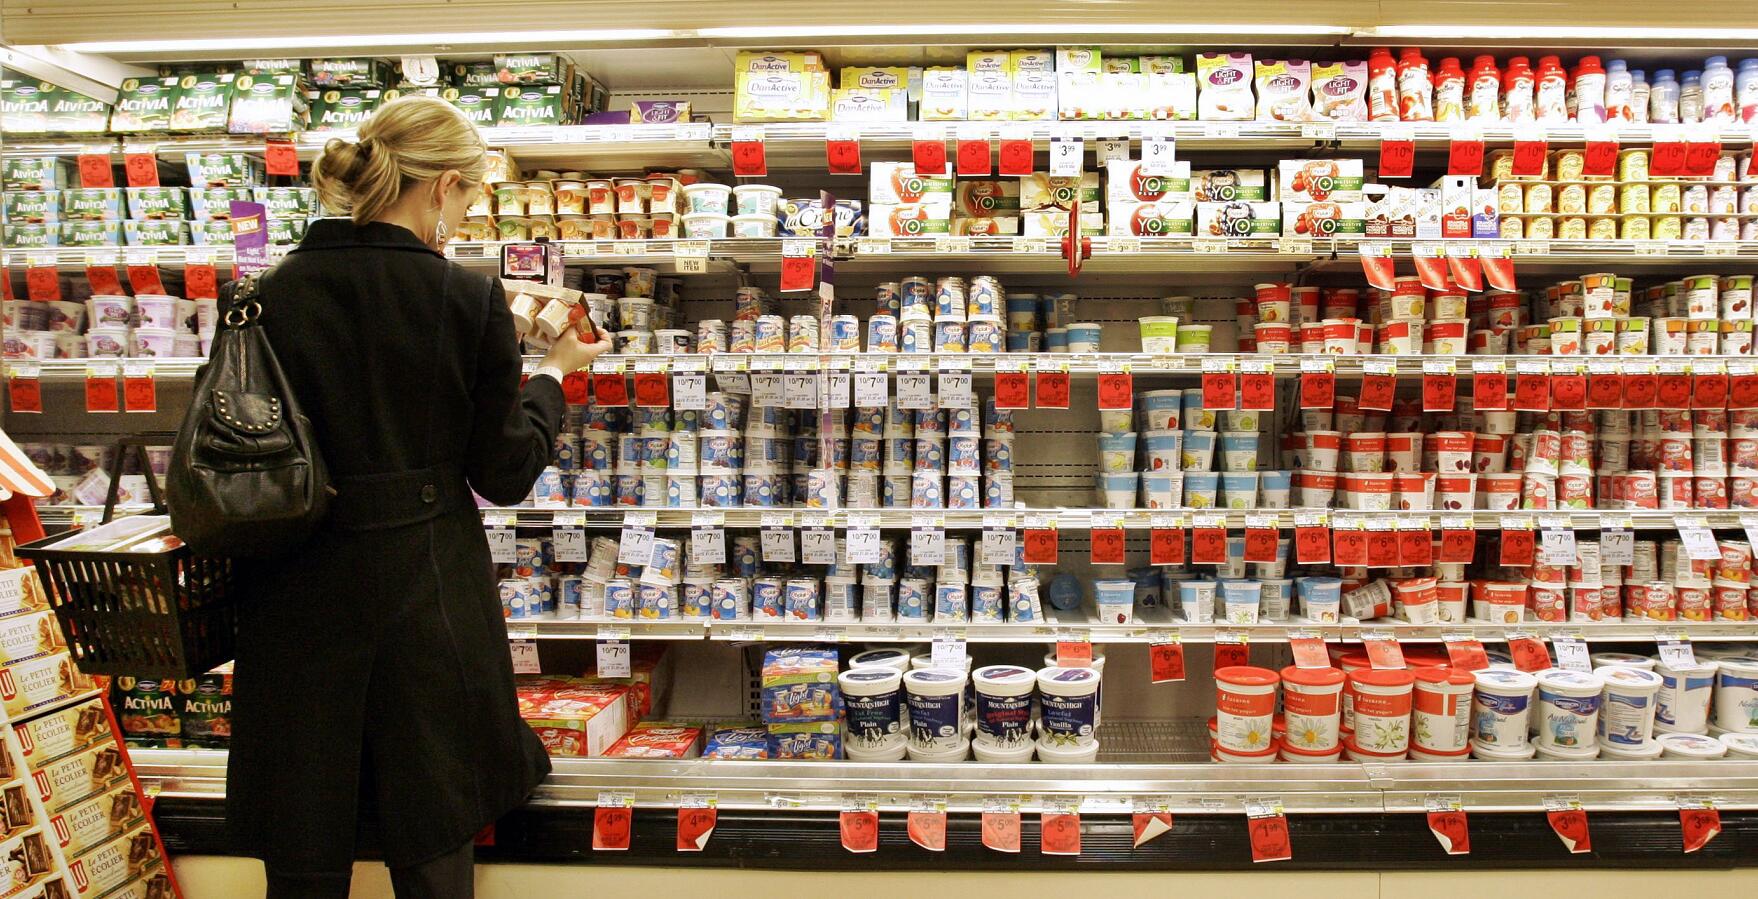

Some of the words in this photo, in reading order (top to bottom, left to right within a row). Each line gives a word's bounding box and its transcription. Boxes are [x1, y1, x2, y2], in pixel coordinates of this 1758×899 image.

[255, 59, 289, 70] ACTIVIA
[323, 60, 358, 72] ACTIVIA
[505, 57, 540, 69] ACTIVIA
[752, 62, 788, 72] DanActive
[861, 76, 897, 85] DanActive
[1215, 71, 1236, 79] LIGHT
[751, 82, 797, 93] DanActive
[1272, 79, 1294, 87] LIGHT
[1329, 79, 1350, 88] LIGHT
[120, 97, 168, 112] ACTIVIA
[176, 93, 224, 109] ACTIVIA
[502, 106, 554, 119] ACTIVIA
[838, 103, 882, 113] DanActive
[138, 199, 169, 210] ACTIVIA
[266, 198, 299, 209] ACTIVIA
[237, 218, 259, 232] NEW
[136, 230, 168, 241] ACTIVIA
[683, 259, 700, 267] NEW
[684, 265, 700, 273] ITEM
[9, 624, 32, 637] PETIT
[20, 675, 28, 683] Le
[30, 668, 52, 680] PETIT
[124, 695, 173, 711] ACTIVIA
[185, 700, 231, 714] ACTIVIA
[34, 724, 41, 732] Le
[43, 714, 65, 728] PETIT
[914, 719, 928, 728] Plain
[1049, 720, 1072, 729] Vanilla
[51, 769, 59, 777] Le
[61, 759, 84, 773] PETIT
[69, 814, 77, 822] Le
[79, 802, 101, 817] PETIT
[88, 858, 96, 867] Le
[97, 845, 119, 861] PETIT
